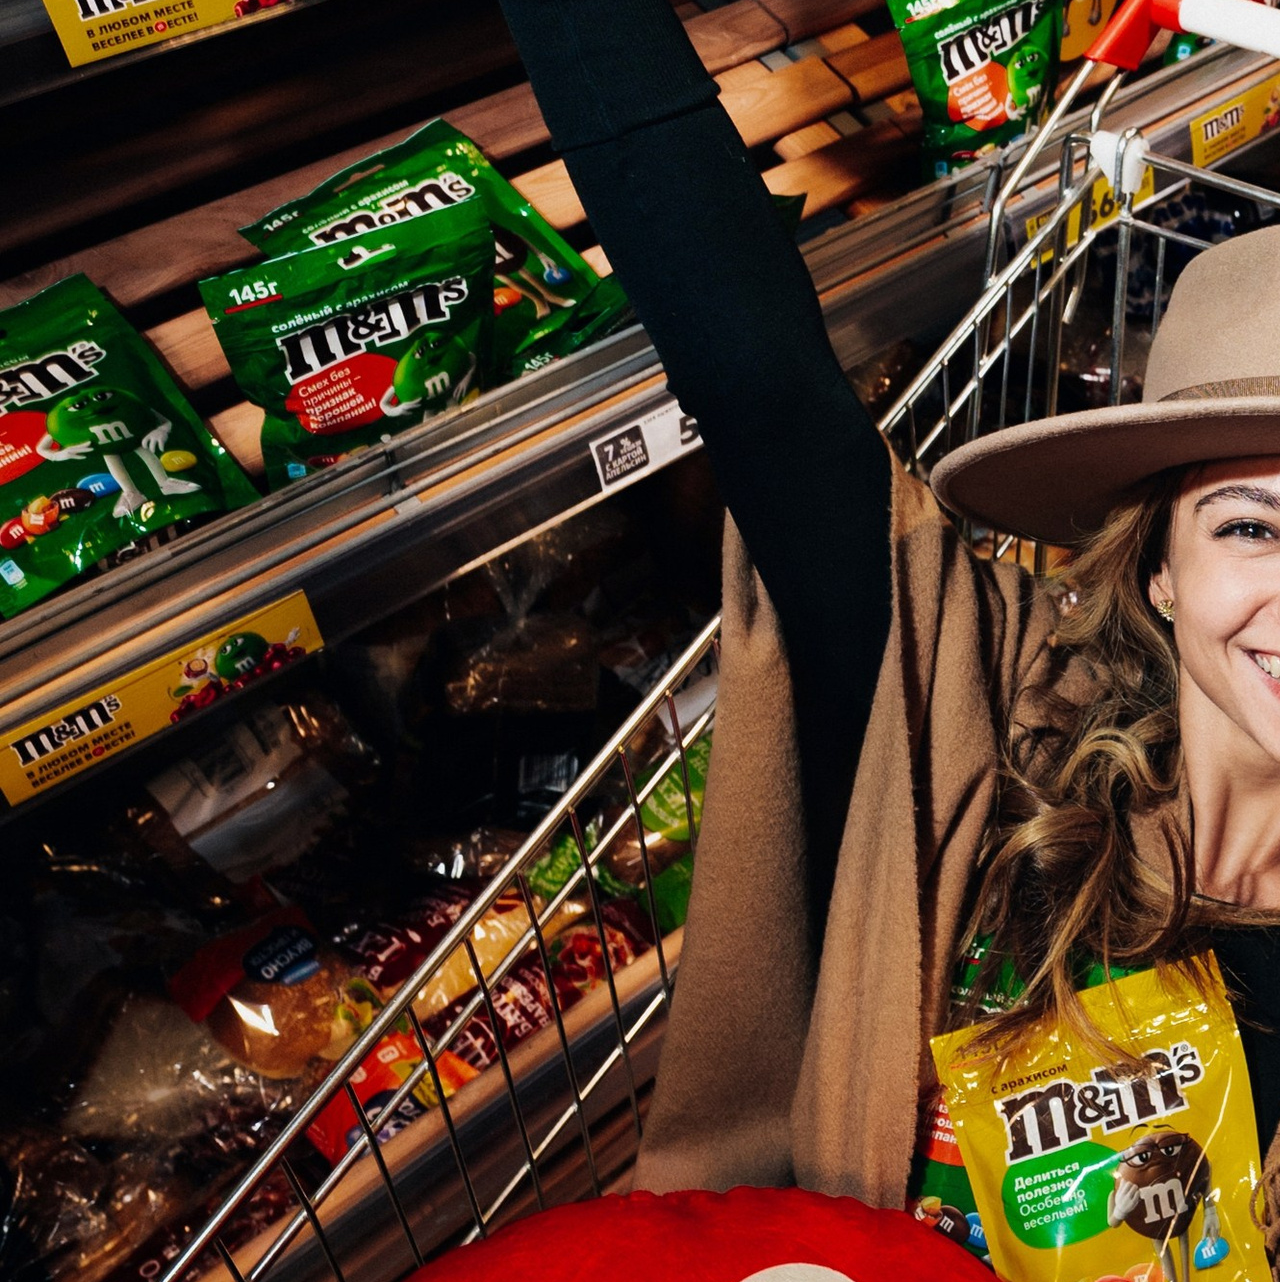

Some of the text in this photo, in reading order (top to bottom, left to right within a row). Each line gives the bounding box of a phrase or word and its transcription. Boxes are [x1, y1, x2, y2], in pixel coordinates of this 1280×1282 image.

[86, 27, 96, 39] В
[98, 11, 151, 37] ЛЮБОМ
[91, 29, 145, 52] ВЕСЕЛЕЕ
[357, 179, 410, 209] арахисом
[229, 280, 278, 306] 145г
[271, 279, 409, 334] солёный с арахисом
[275, 275, 469, 386] m&m's
[298, 366, 351, 399] Смех без
[303, 377, 353, 407] причины
[424, 370, 449, 399] m
[305, 387, 357, 416] признак
[89, 420, 135, 446] m
[603, 443, 614, 462] 7
[606, 454, 647, 481] АПЕЛЬСИН
[612, 447, 643, 468] КАРТОЙ
[234, 655, 255, 672] m
[9, 694, 123, 767] m&m's
[26, 721, 132, 780] В ЛЮБОМ МЕСТЕ
[31, 756, 84, 789] ВЕСЕЛЕЕ
[259, 935, 314, 982] ВКУСНО
[991, 1064, 1068, 1094] с арахисом
[994, 1041, 1205, 1166] m&m's
[1013, 1161, 1081, 1192] Делиться
[1139, 1175, 1189, 1223] m
[940, 1215, 955, 1233] m
[1023, 1200, 1089, 1231] весельем!
